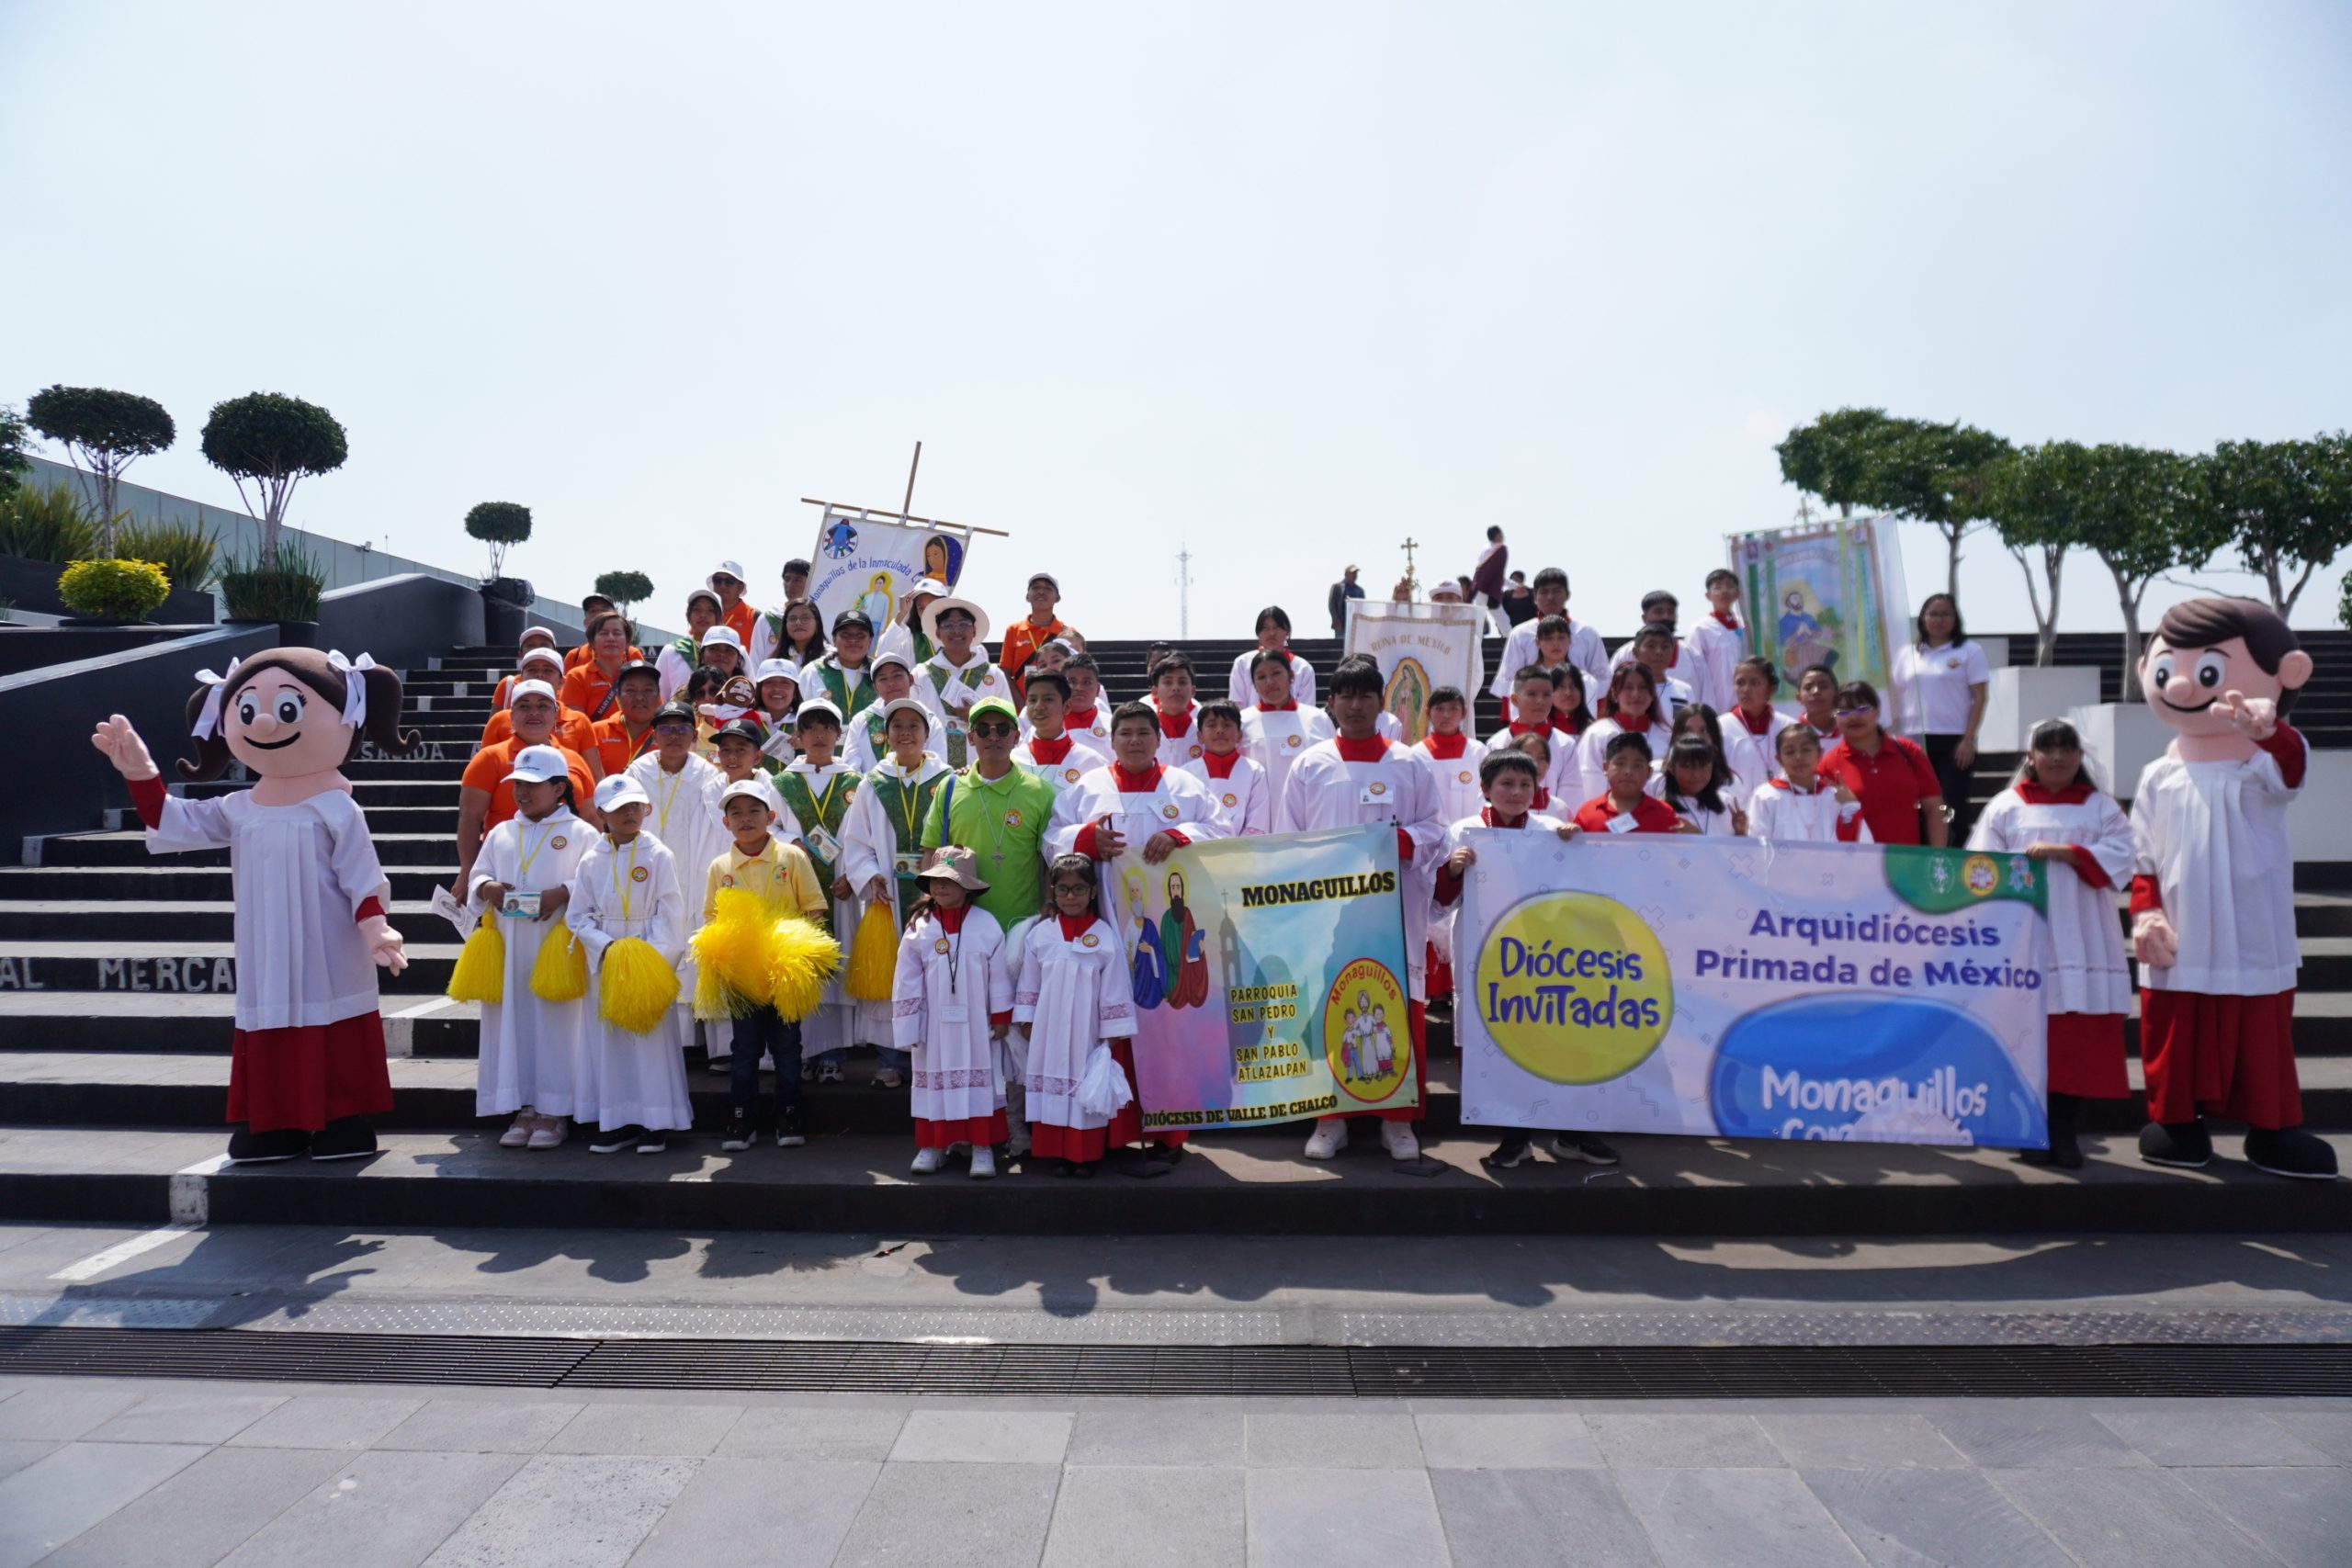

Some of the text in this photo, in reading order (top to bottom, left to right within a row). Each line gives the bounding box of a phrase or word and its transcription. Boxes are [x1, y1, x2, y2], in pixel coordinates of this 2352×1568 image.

[847, 559, 858, 571] de
[858, 557, 866, 569] la
[1399, 634, 1411, 645] DE
[1241, 871, 1396, 908] MONAGUILLOS
[1749, 909, 2001, 947] Arquidiócesis
[1500, 937, 1643, 981] Diócesis
[1695, 950, 2042, 991] Primada de México
[1231, 984, 1298, 1003] PARROQUIA
[1331, 965, 1396, 1006] Monaguillos
[1233, 1004, 1296, 1023] SAN PEDRO
[1267, 1026, 1275, 1040] Y
[1236, 1043, 1299, 1063] SAN PABLO
[1238, 1061, 1307, 1082] ATLAZALPAN
[1761, 1064, 1988, 1120] Monaguillos
[1143, 1094, 1339, 1127] DIÓCESIS DE VALLE DE CHALCO
